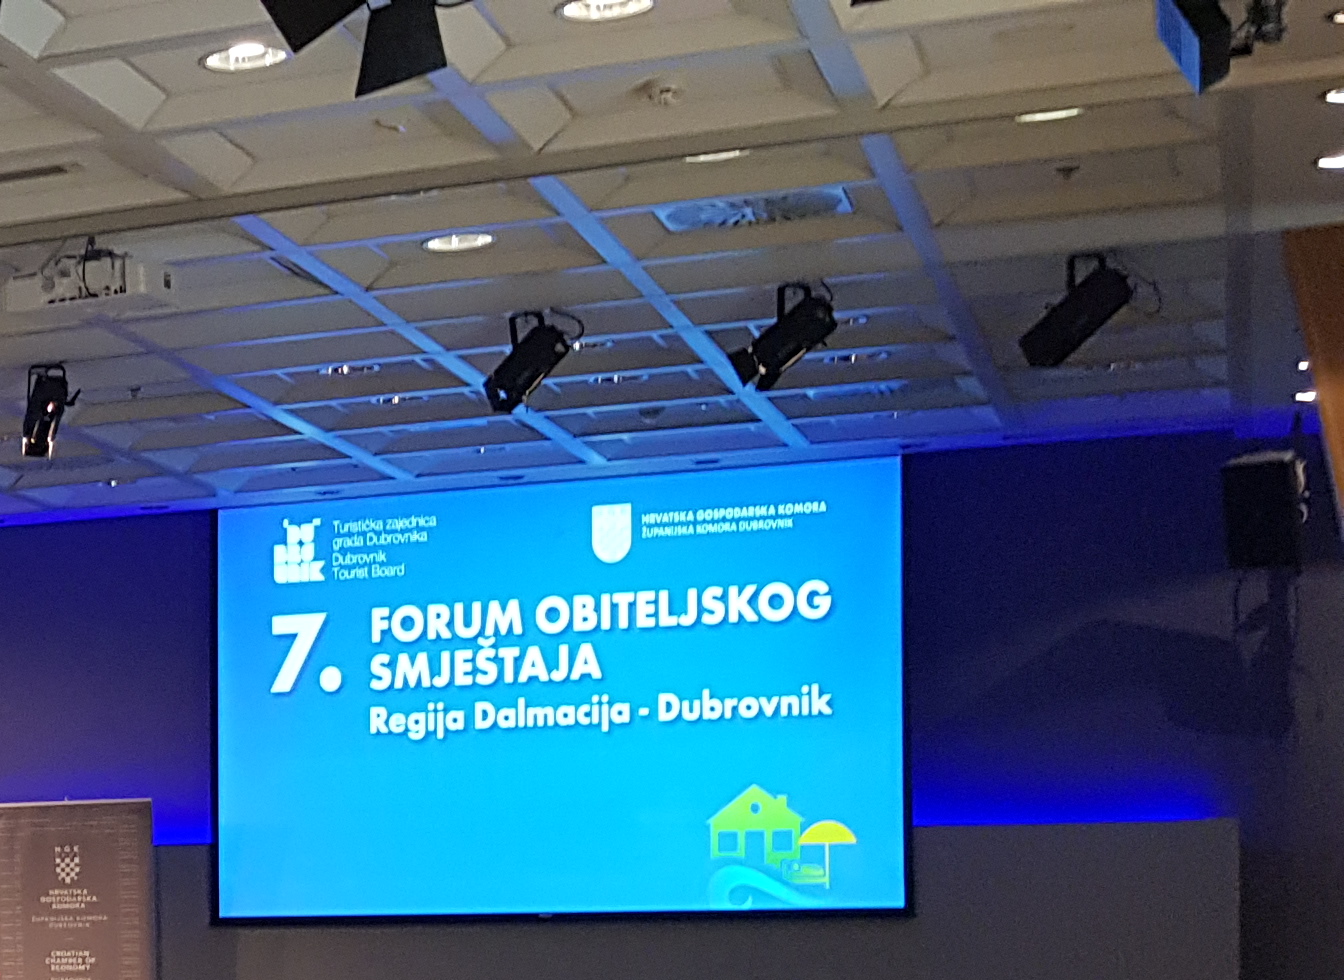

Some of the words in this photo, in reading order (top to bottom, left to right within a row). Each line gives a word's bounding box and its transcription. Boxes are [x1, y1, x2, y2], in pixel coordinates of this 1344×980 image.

[332, 518, 384, 534] Turistička
[386, 514, 437, 531] zajednica
[641, 509, 695, 525] HRVATSKA
[696, 504, 776, 521] GOSPODARSKA
[777, 500, 827, 516] KOMORA
[696, 520, 738, 535] KOMORA
[739, 517, 794, 532] DUBROVNIK
[332, 534, 365, 551] grada
[366, 530, 428, 547] Dubrovnika
[332, 550, 387, 566] Dubrovnik
[332, 566, 369, 580] Tourist
[372, 563, 406, 578] Board
[370, 598, 524, 644] FORUM
[534, 578, 833, 636] OBITELJSKOG
[269, 611, 342, 694] 7.
[368, 635, 603, 692] SMJEŠTAJA
[368, 702, 465, 740] Regija
[473, 695, 631, 737] Dalmacija
[657, 684, 833, 723] Dubrovnik
